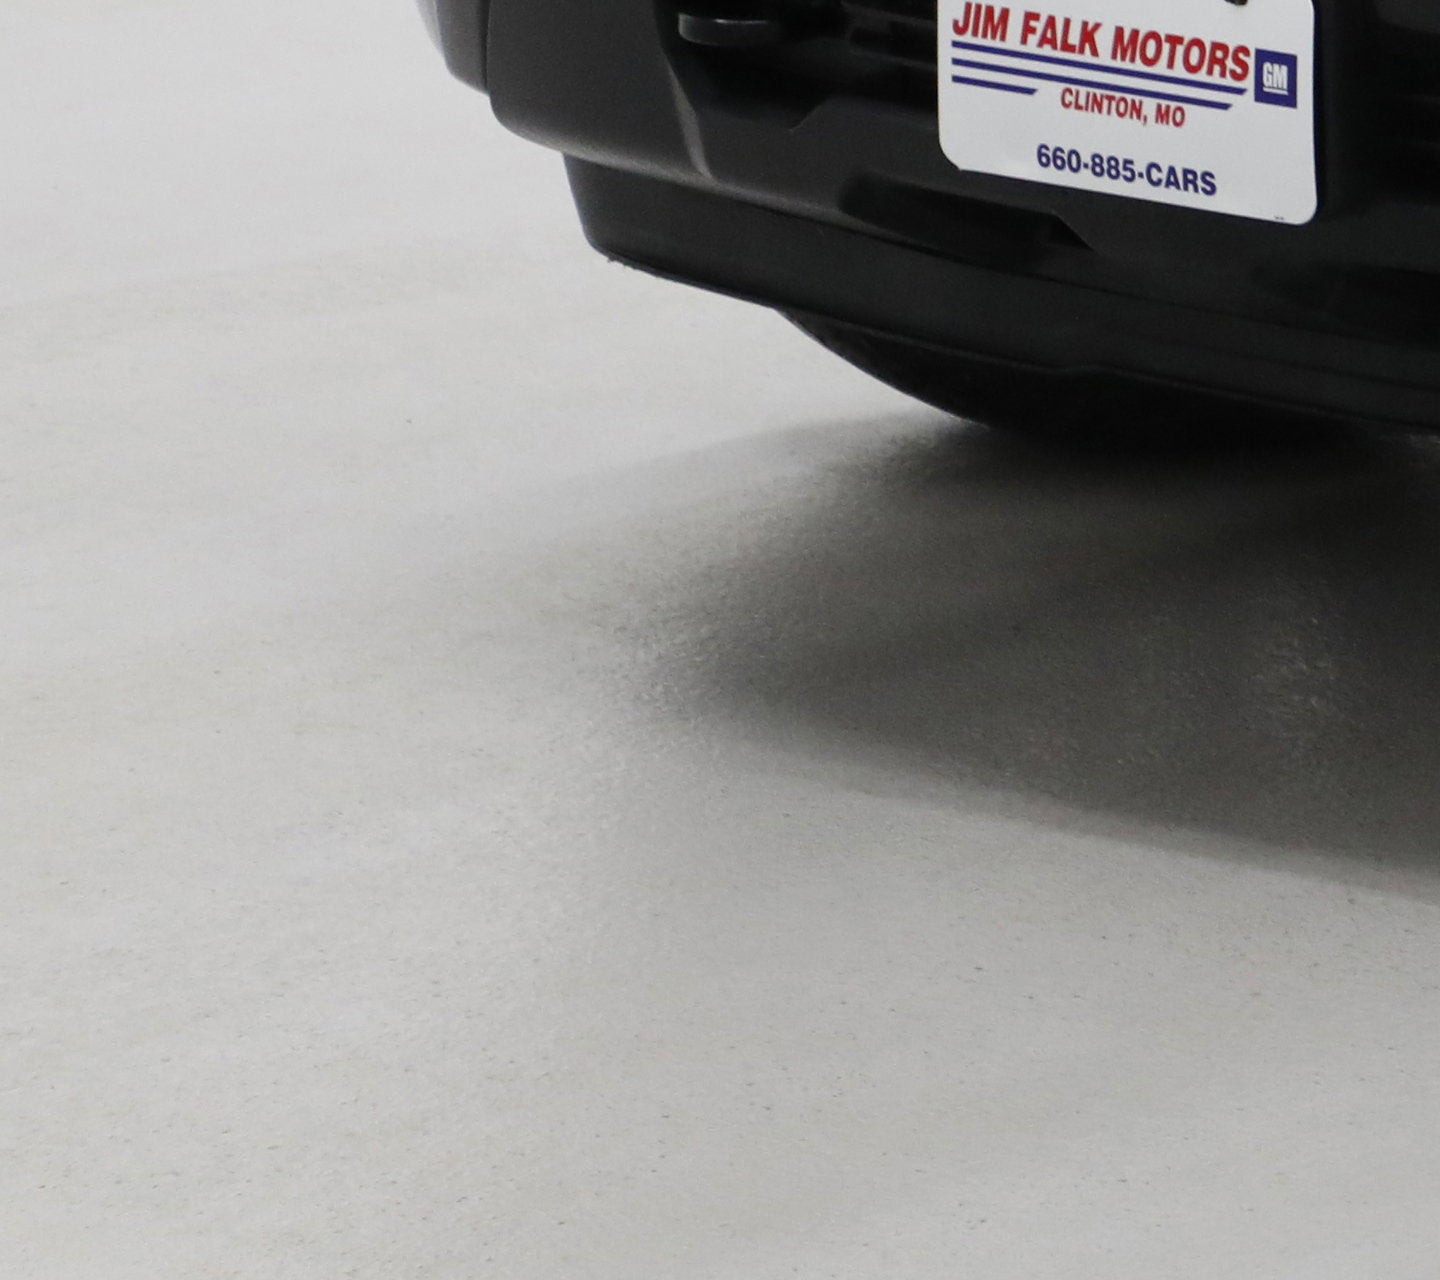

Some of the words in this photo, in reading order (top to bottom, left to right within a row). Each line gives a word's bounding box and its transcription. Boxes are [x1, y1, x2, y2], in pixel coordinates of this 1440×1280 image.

[952, 1, 1009, 42] JIM
[1020, 10, 1103, 58] FALK
[1111, 25, 1251, 82] MOTORS
[1262, 61, 1288, 90] GM
[1060, 87, 1148, 126] CLINTON,
[1155, 105, 1186, 127] MO
[1036, 143, 1217, 196] 660-885-CARS
